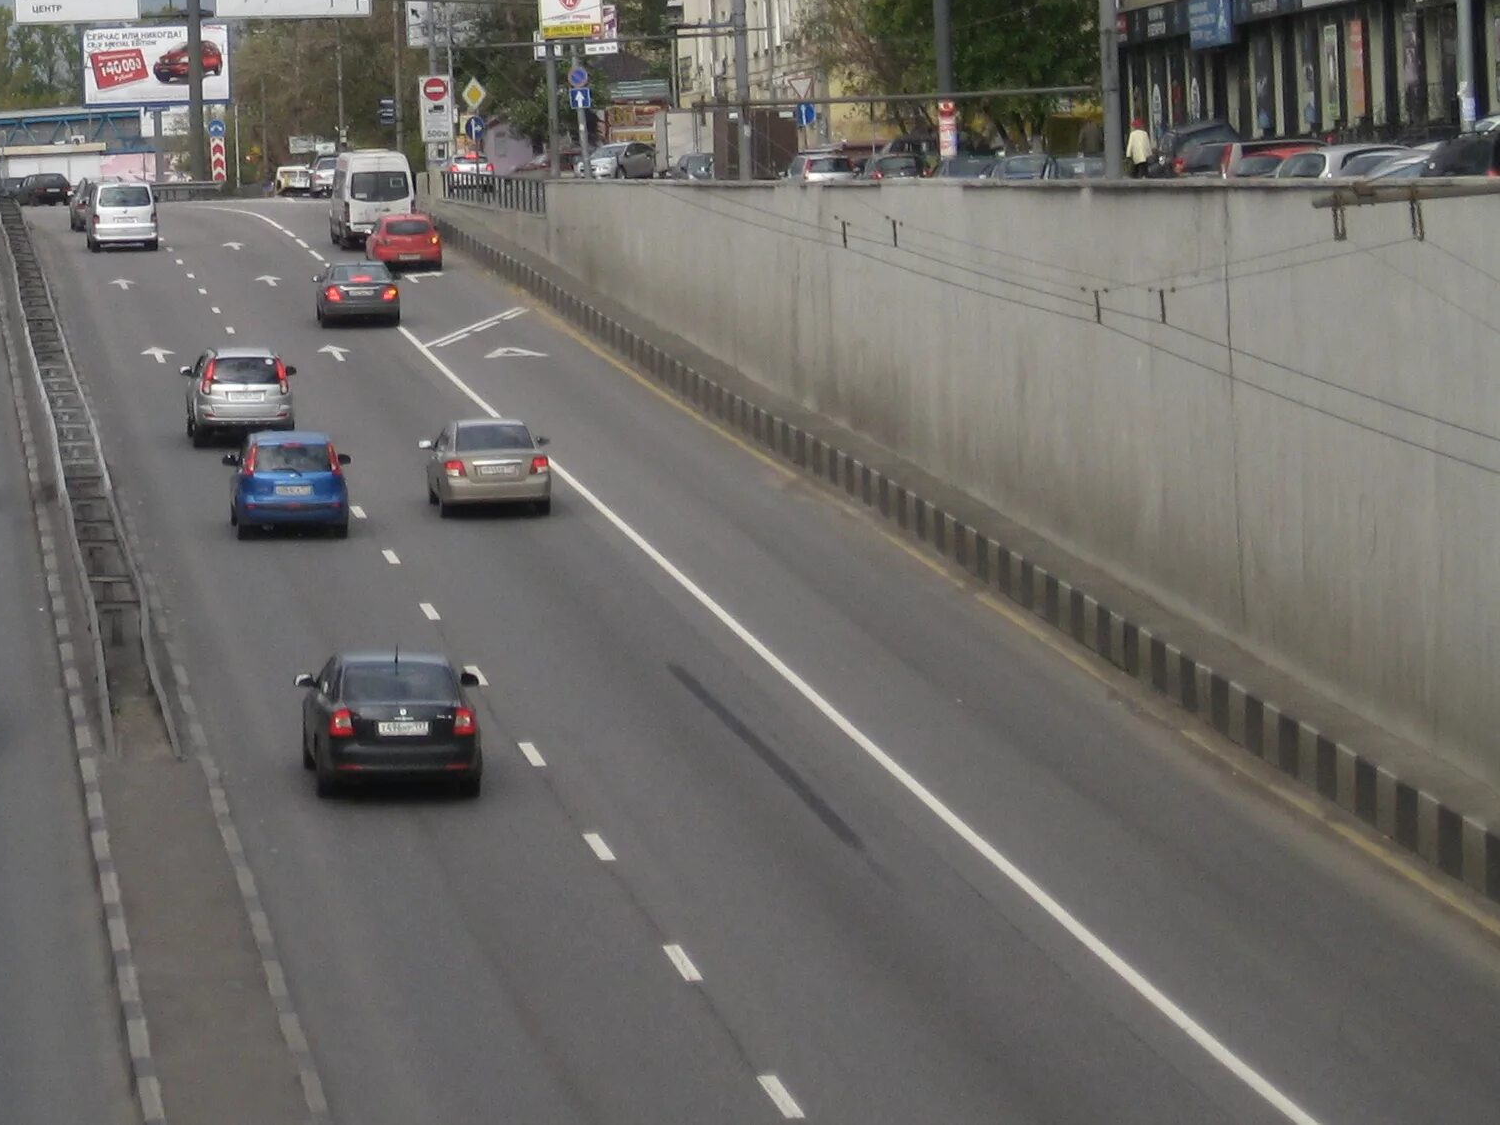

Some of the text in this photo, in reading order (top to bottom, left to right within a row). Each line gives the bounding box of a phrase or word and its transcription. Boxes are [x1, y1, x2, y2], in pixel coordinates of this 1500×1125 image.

[32, 4, 63, 14] ЦЕНТР
[86, 30, 182, 41] СЕЙЧАС ИЛИ НИКОГДА!
